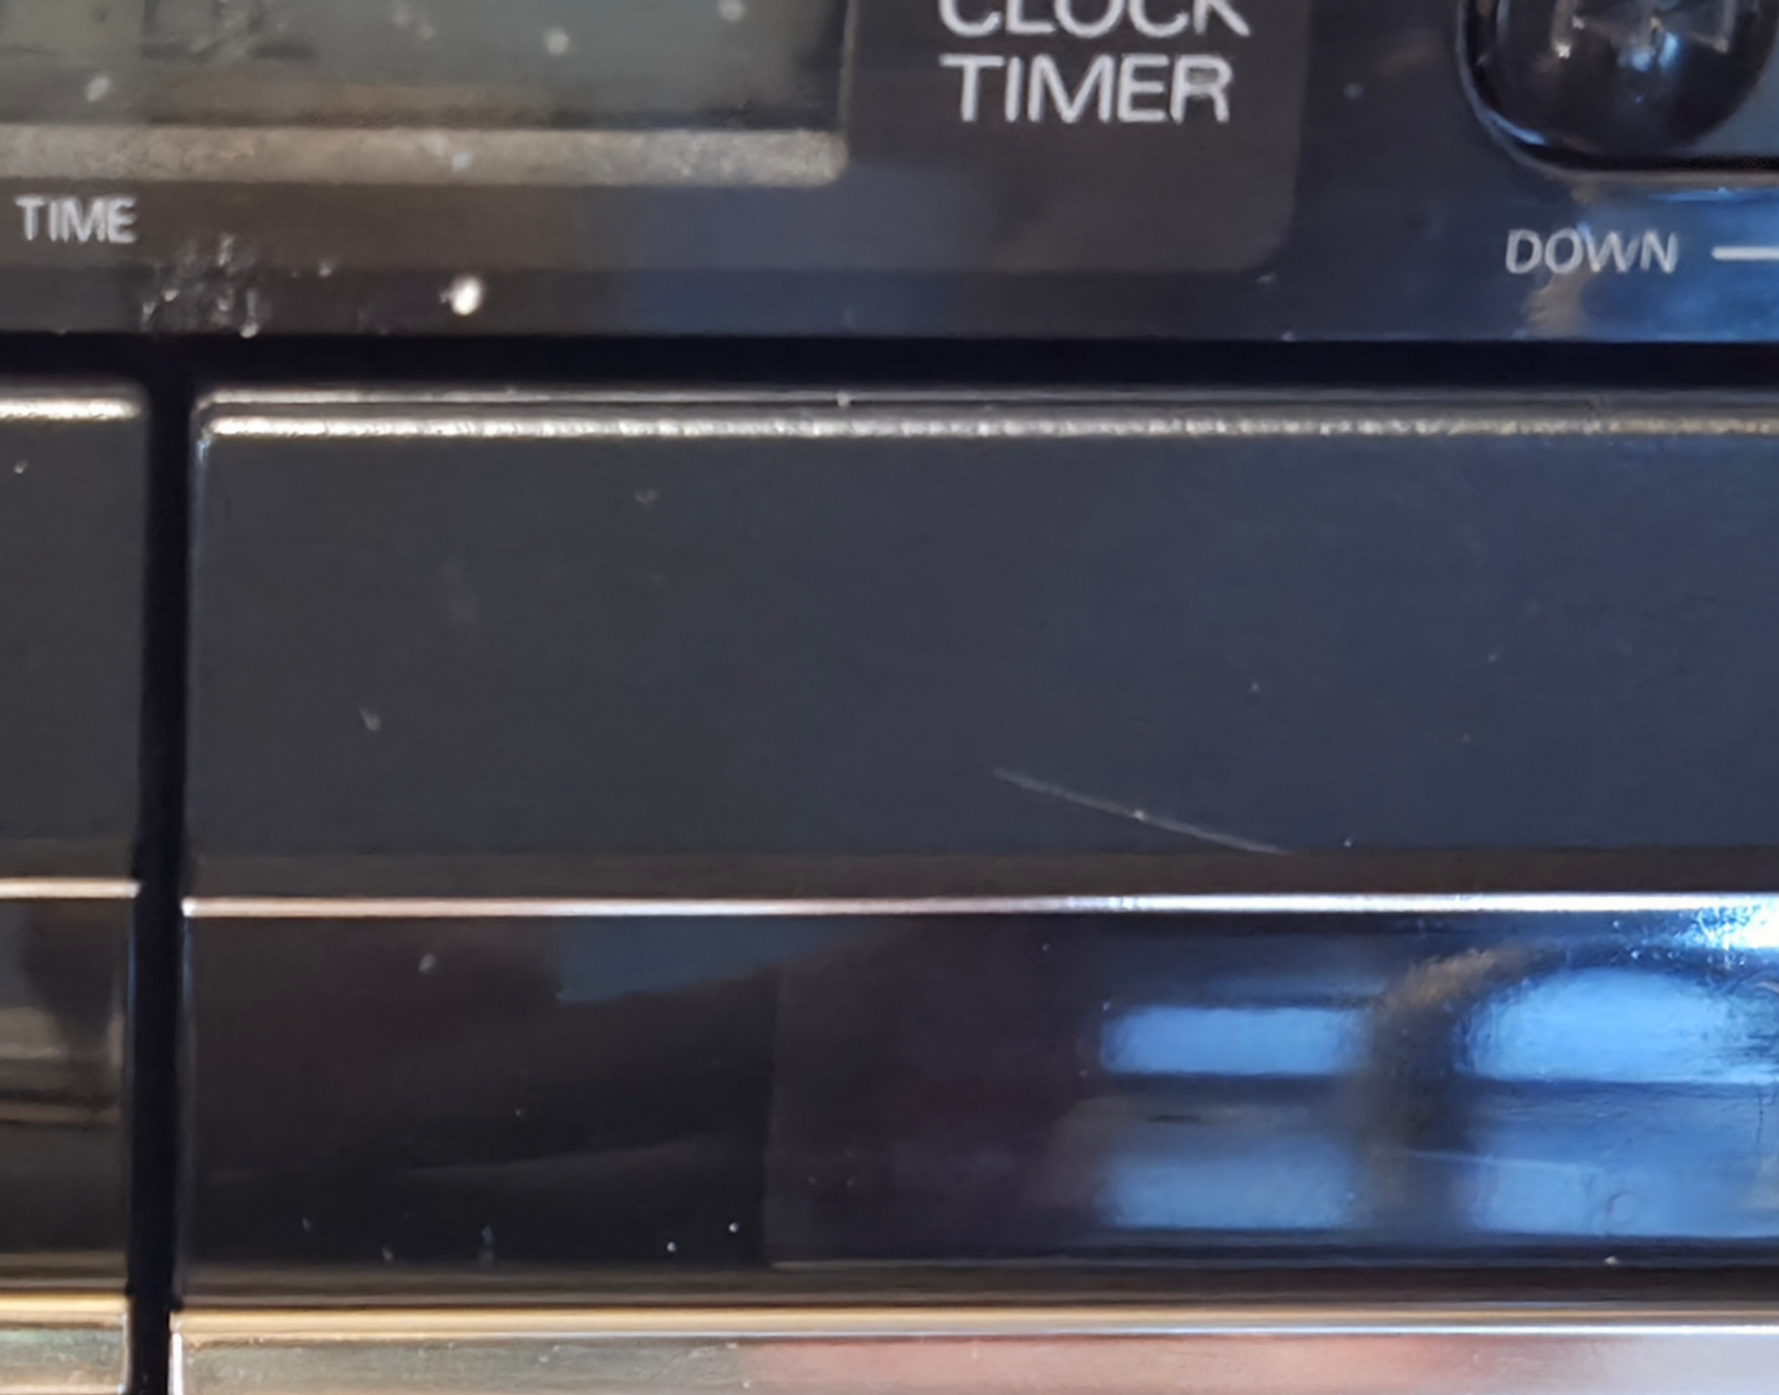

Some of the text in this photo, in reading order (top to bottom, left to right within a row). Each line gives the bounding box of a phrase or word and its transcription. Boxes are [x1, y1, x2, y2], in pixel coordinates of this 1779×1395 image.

[941, 54, 1233, 124] TIMER
[15, 195, 134, 243] TIME
[1506, 224, 1679, 276] DOWN
